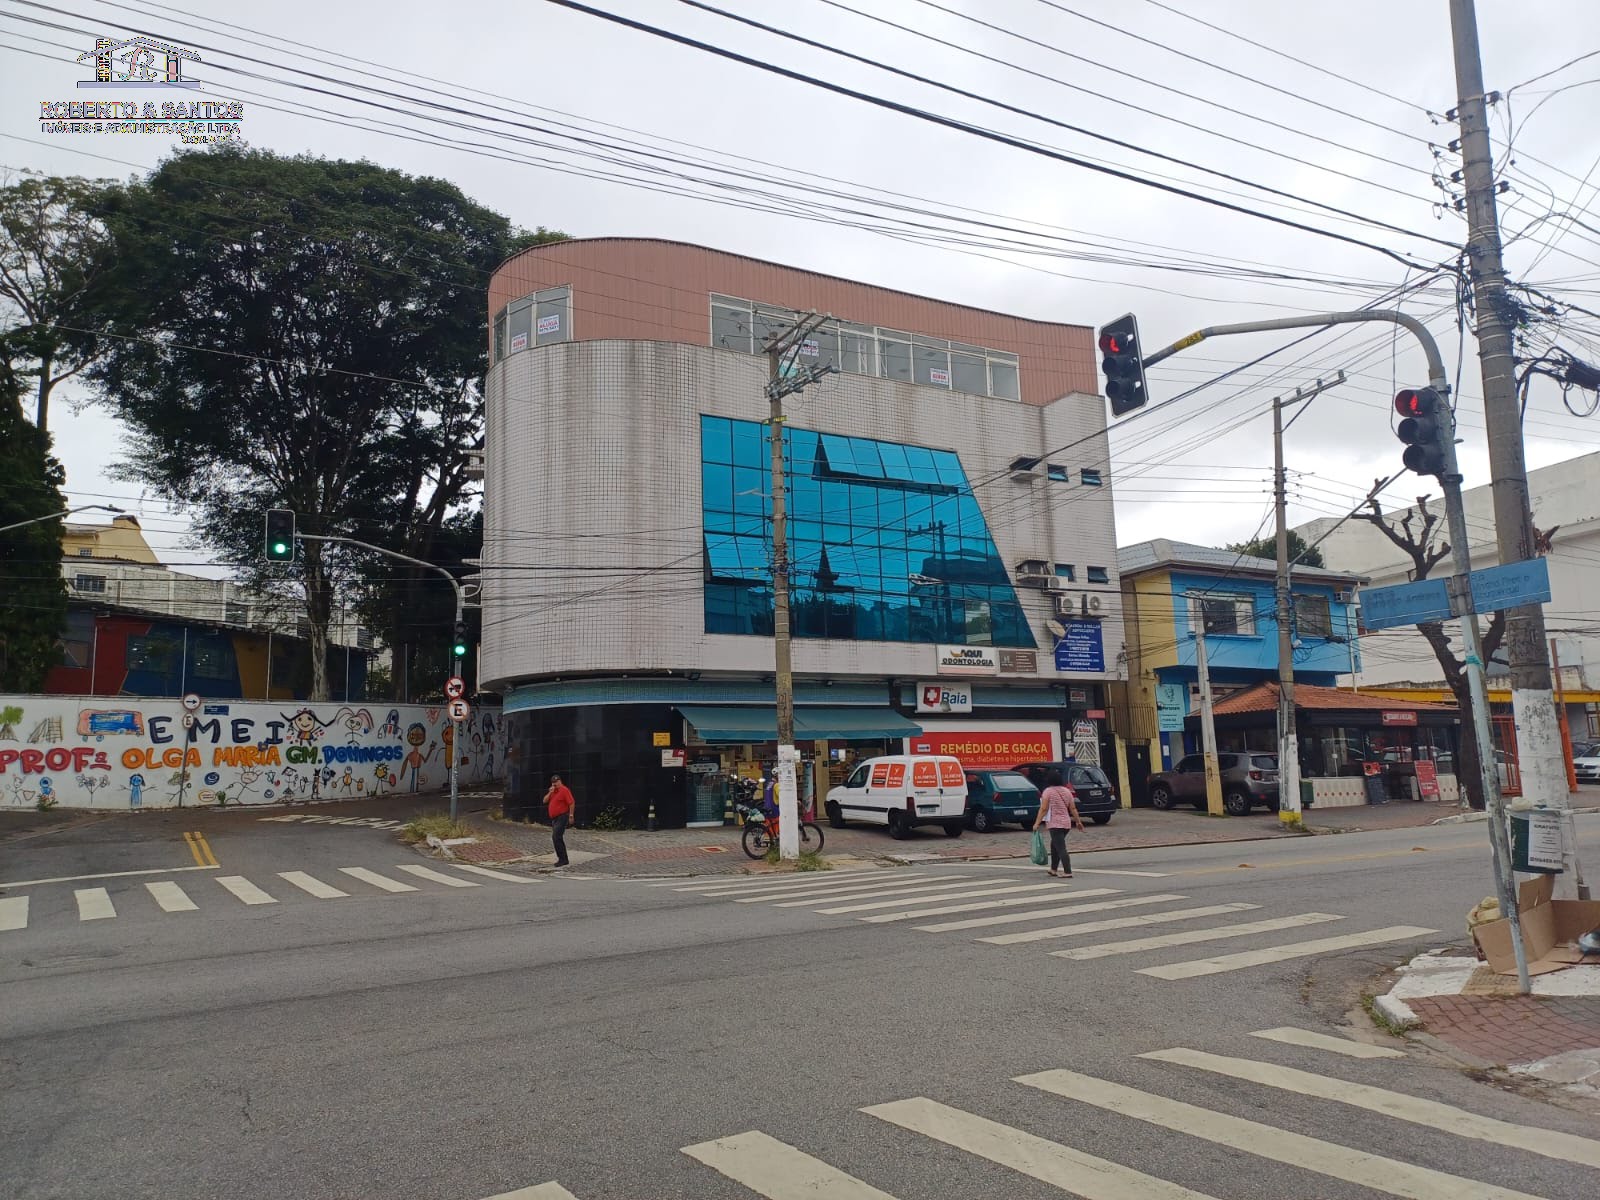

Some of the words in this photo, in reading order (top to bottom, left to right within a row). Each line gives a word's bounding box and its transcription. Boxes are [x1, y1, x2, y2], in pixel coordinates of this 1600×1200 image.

[959, 649, 983, 659] AQUI
[942, 658, 994, 666] ODONTOLOGIA
[940, 740, 993, 754] REMÉDIO
[994, 743, 1011, 754] DE
[1011, 743, 1048, 756] GRAÇA
[121, 747, 201, 770] OLGA
[213, 745, 281, 768] MARIA
[322, 745, 403, 764] DOMINGOS
[977, 755, 1005, 763] diabetes
[1010, 755, 1047, 764] hipertensão
